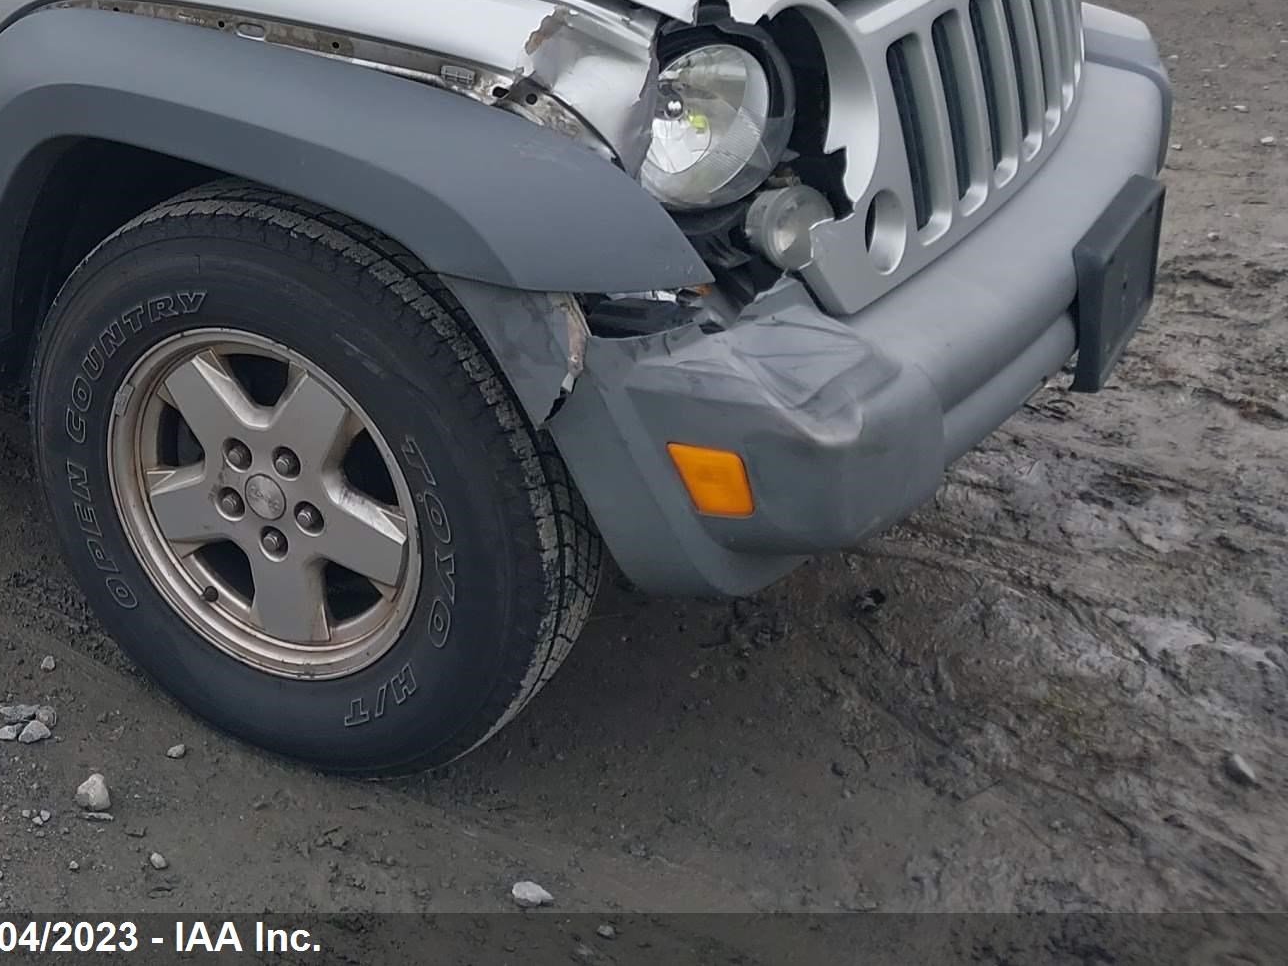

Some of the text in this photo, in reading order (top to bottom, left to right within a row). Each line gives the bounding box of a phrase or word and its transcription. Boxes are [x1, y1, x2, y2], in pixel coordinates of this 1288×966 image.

[65, 291, 209, 610] OPEN COUNTRY
[400, 435, 456, 650] TOYO
[343, 661, 418, 726] H/T
